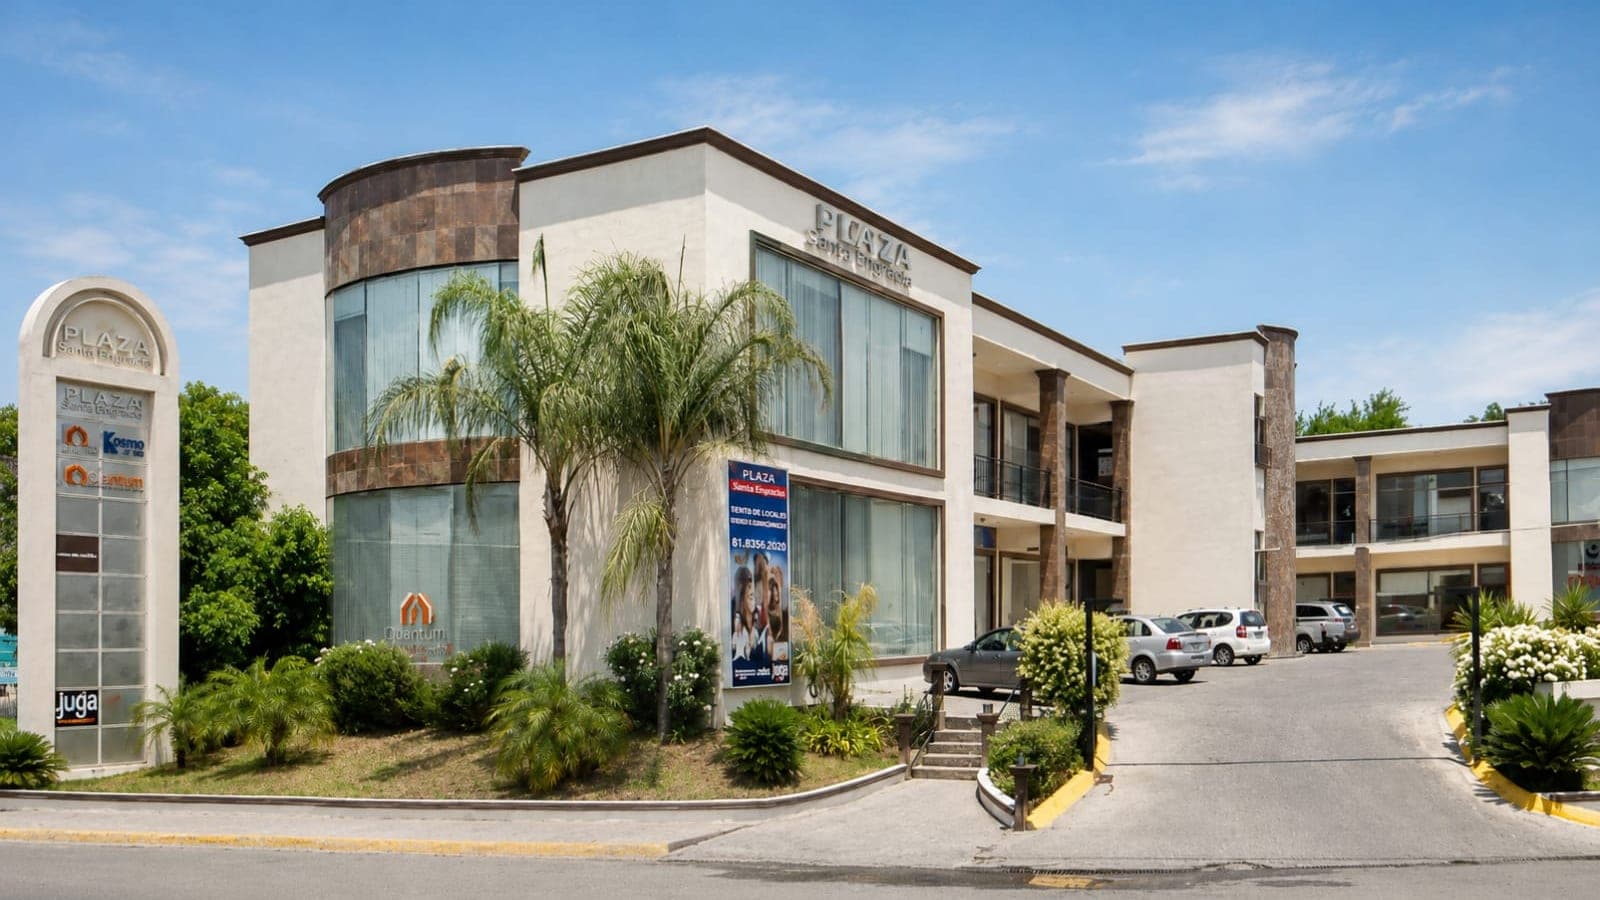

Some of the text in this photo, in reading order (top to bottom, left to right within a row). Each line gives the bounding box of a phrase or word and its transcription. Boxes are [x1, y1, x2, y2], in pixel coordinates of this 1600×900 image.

[62, 324, 149, 356] PLAZA
[64, 387, 143, 411] PLAZA
[103, 431, 145, 454] Kosmo
[742, 469, 775, 484] PLAZA
[384, 626, 446, 642] Quantum
[56, 691, 98, 719] juga
